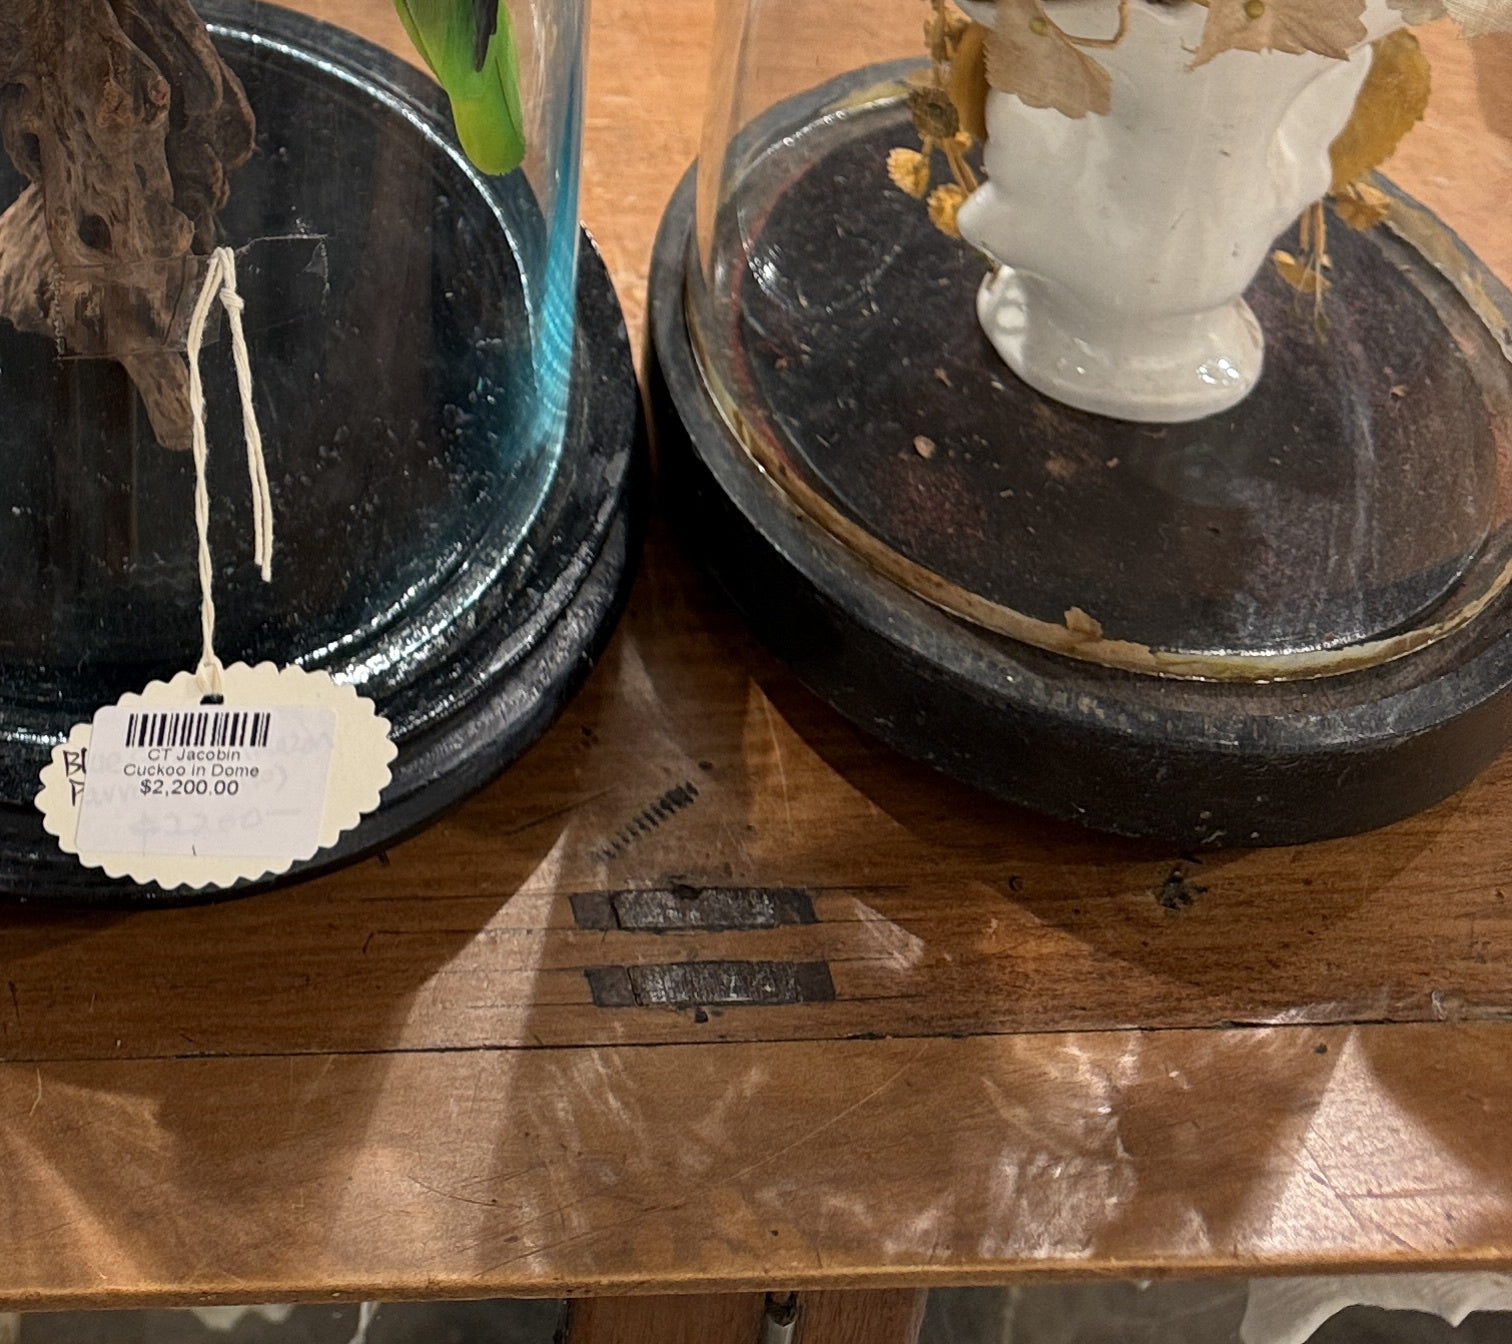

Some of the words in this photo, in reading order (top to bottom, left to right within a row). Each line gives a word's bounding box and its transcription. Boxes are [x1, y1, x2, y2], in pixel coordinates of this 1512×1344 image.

[148, 748, 172, 761] CT
[176, 748, 240, 761] Jacobin
[123, 763, 186, 777] Cuckoo
[191, 763, 206, 777] in
[211, 763, 260, 777] Dome
[139, 779, 239, 797] $2,200.00
